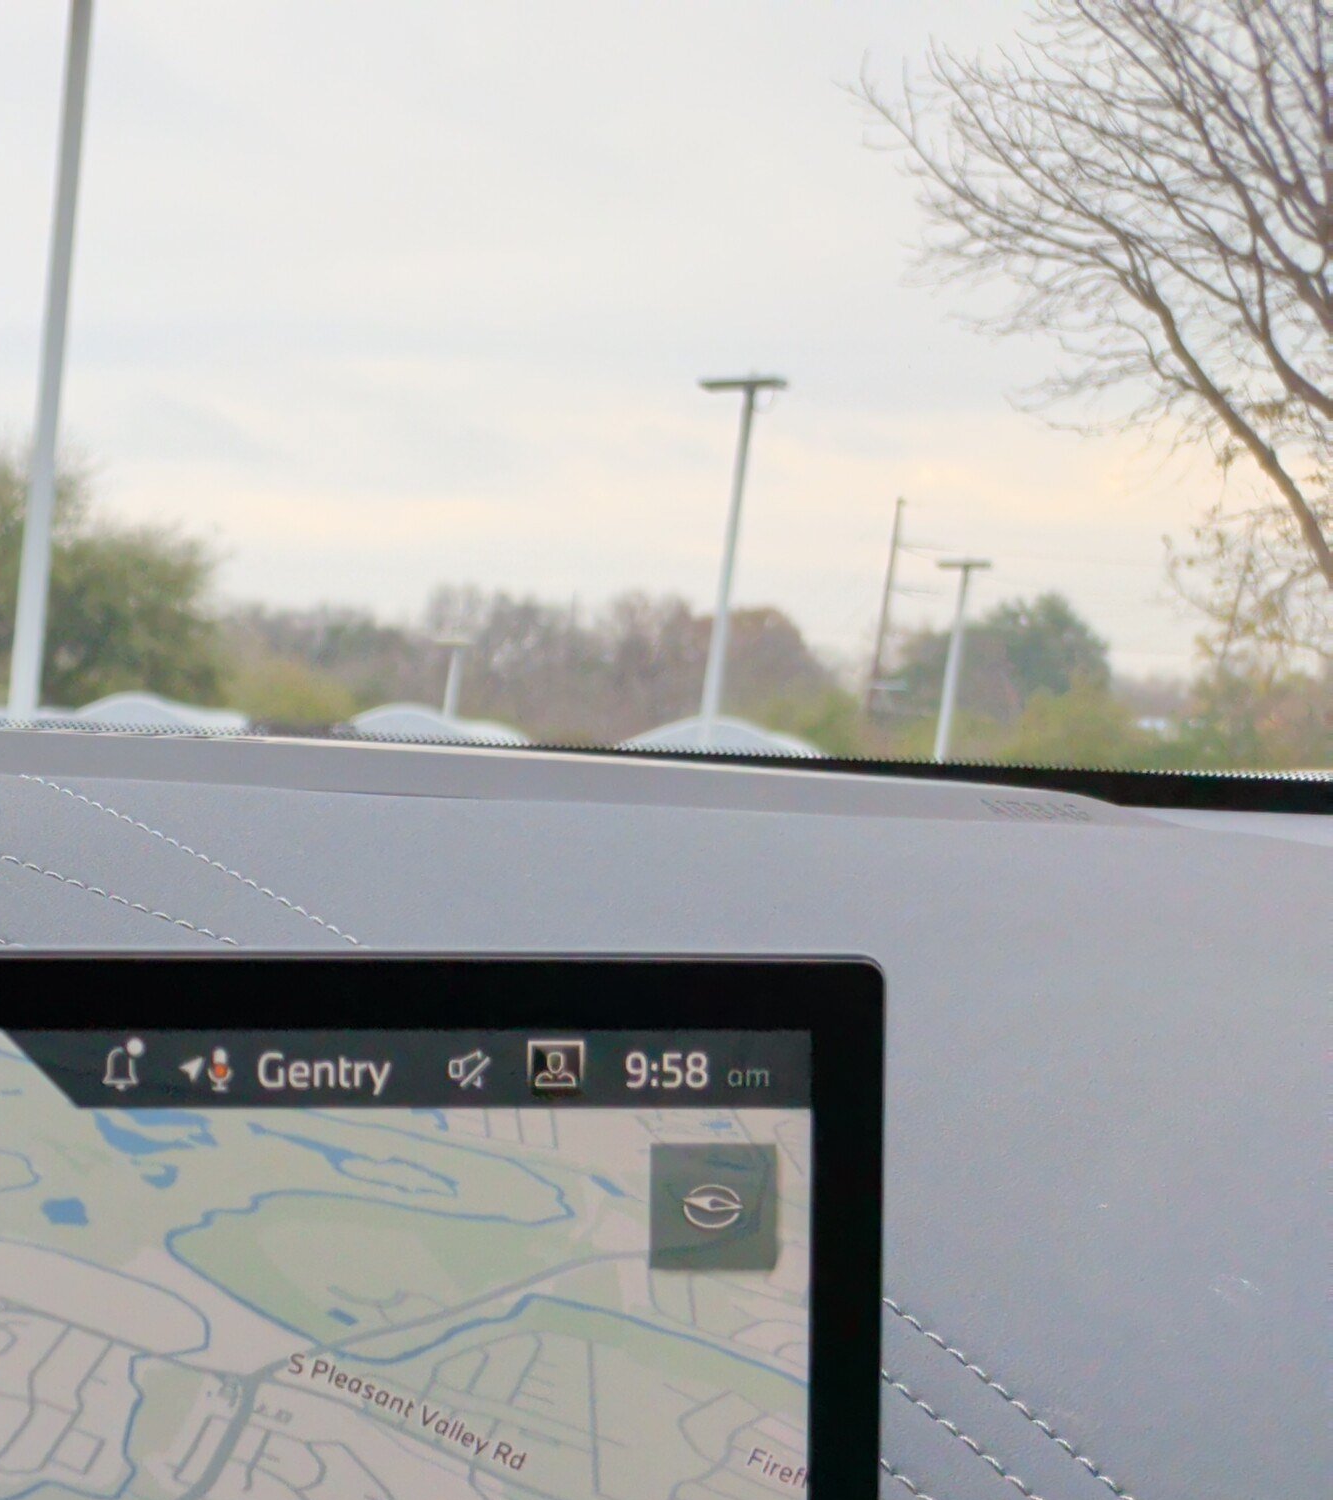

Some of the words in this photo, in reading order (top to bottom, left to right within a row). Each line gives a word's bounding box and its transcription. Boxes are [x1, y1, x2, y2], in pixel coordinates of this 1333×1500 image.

[981, 799, 1091, 822] AIRBAG
[257, 1051, 392, 1094] Gentry
[624, 1052, 709, 1089] 9:58
[727, 1067, 770, 1088] am
[287, 1353, 306, 1375] S
[310, 1359, 415, 1418] Pleasant
[420, 1405, 490, 1456] Valley
[492, 1441, 528, 1471] Rd
